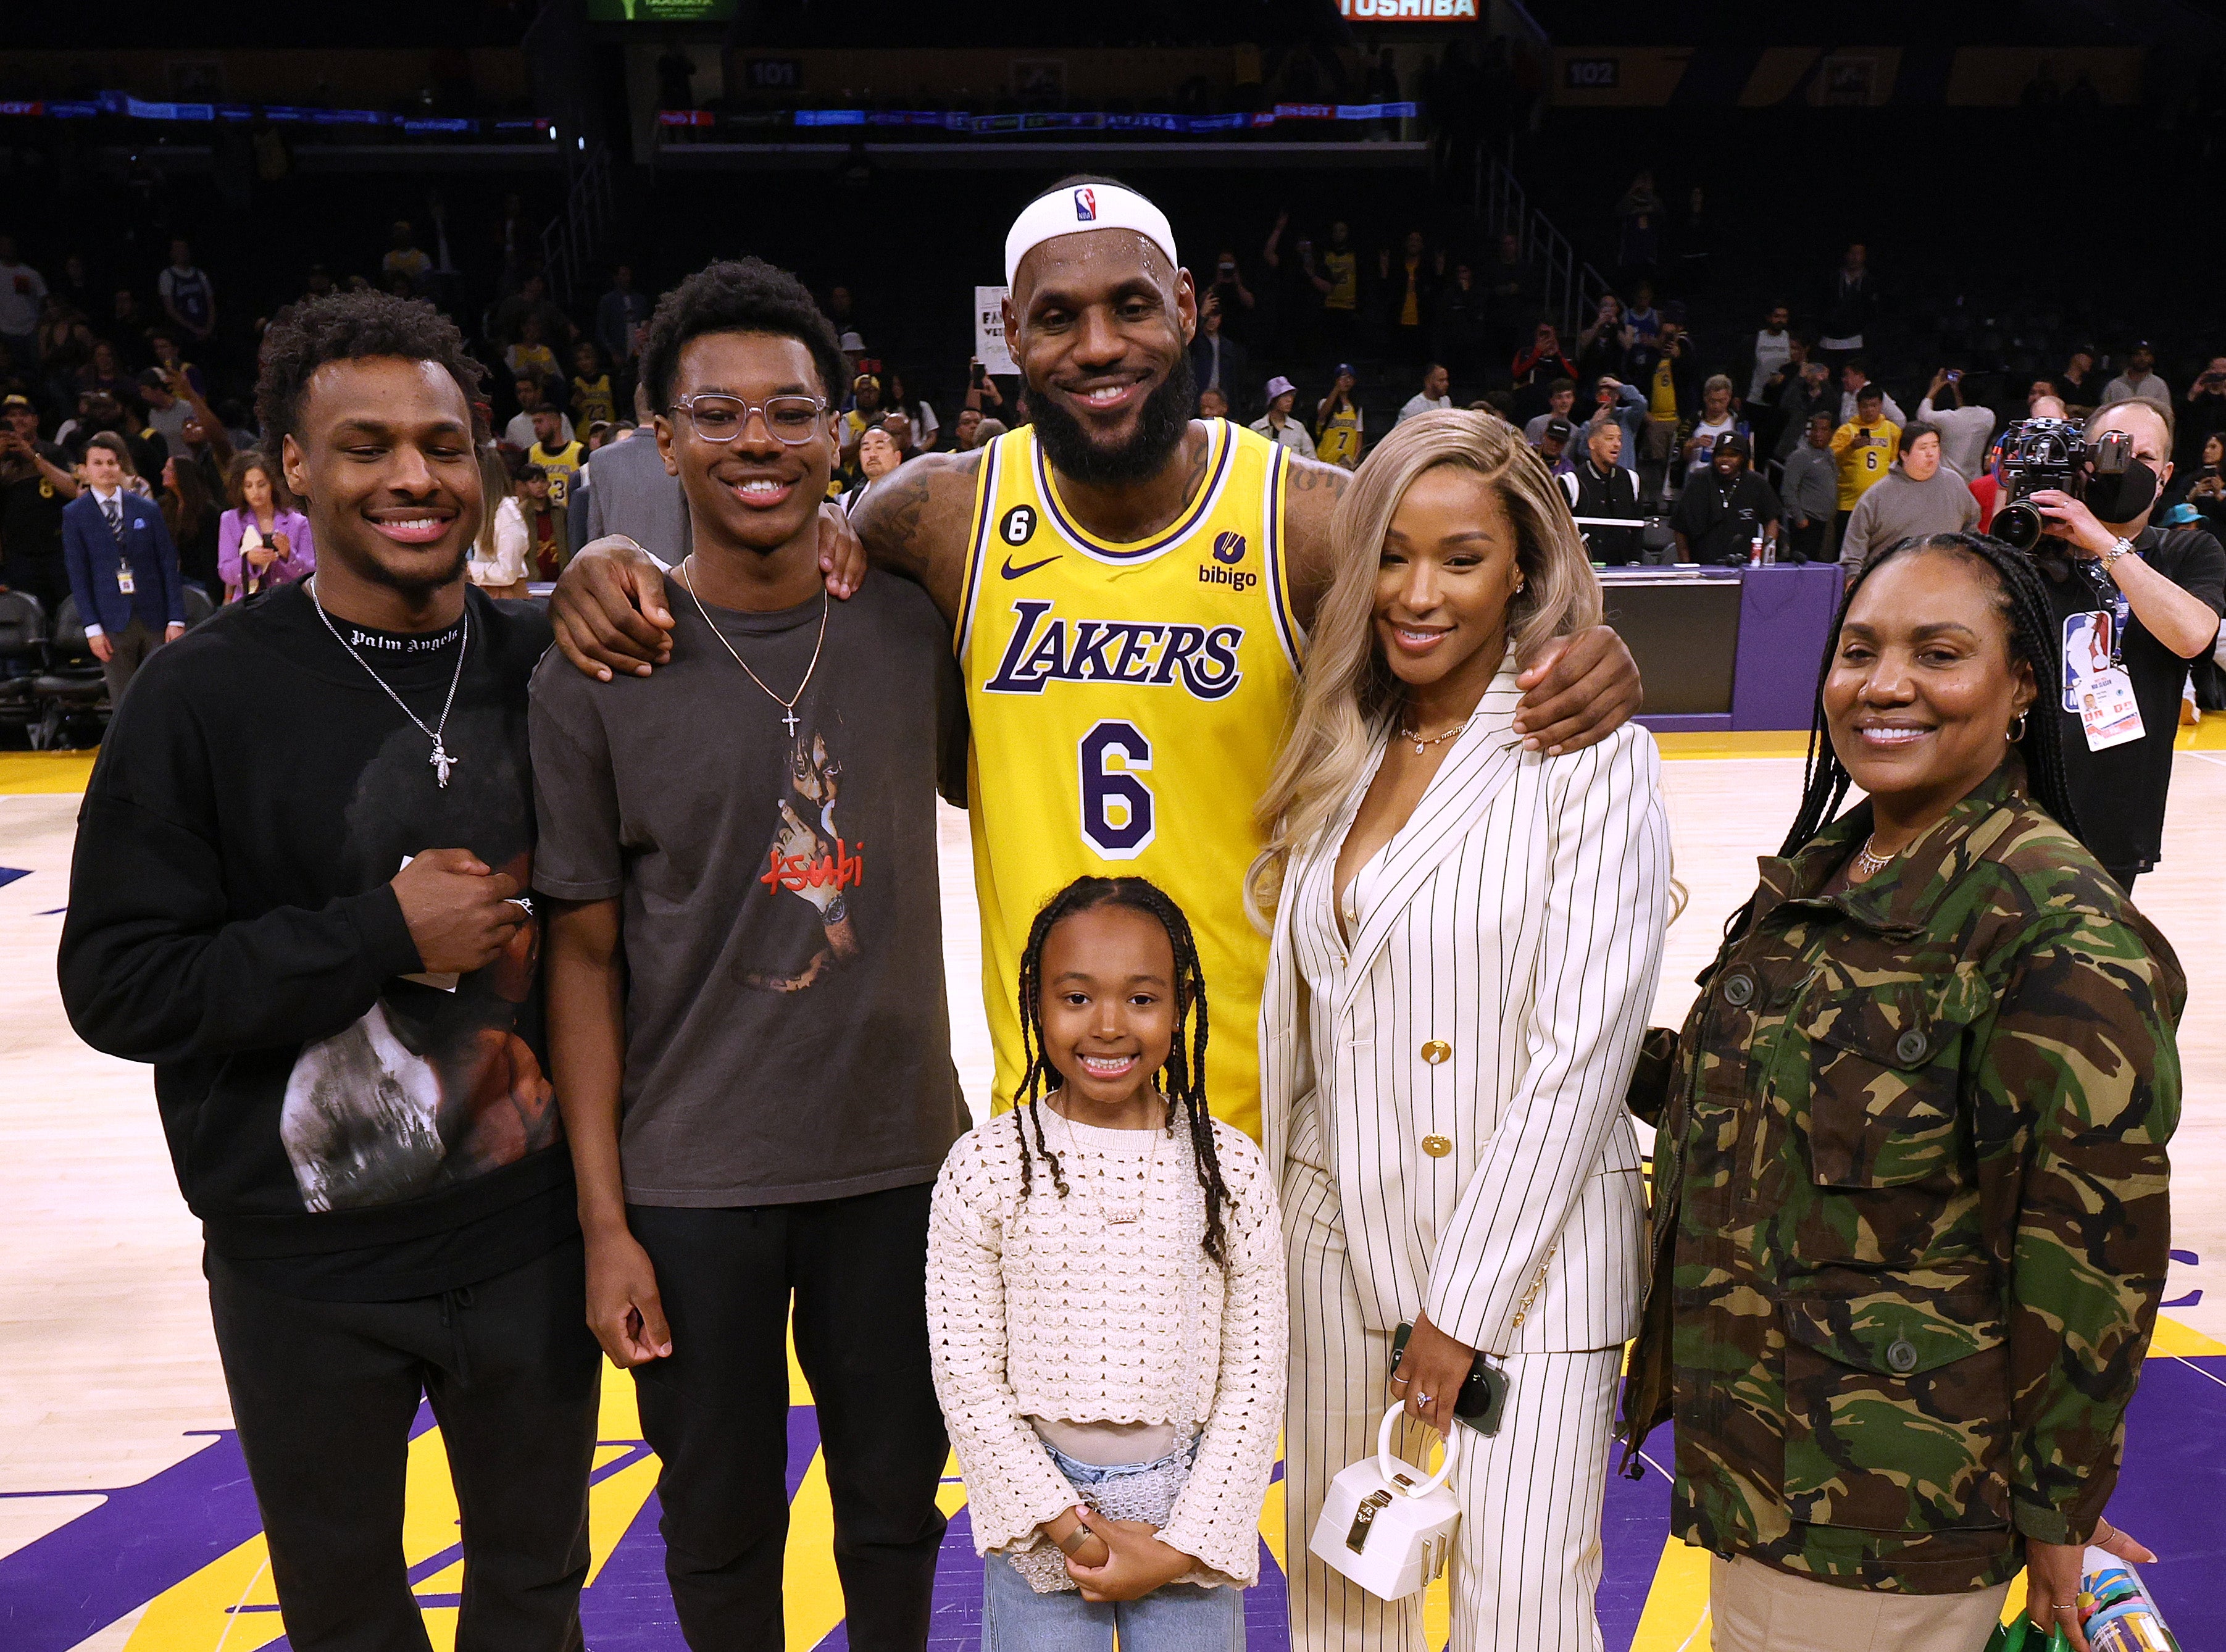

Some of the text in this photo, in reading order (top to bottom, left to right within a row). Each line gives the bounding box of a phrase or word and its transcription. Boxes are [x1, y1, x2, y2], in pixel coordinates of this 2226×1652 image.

[1338, 430, 1349, 450] 7
[1866, 451, 1878, 470] 6
[1008, 509, 1029, 541] 6
[1198, 564, 1257, 592] bibigo
[350, 629, 458, 653] Palm Angels
[982, 598, 1245, 702] LAKERS
[1077, 718, 1156, 862] 6
